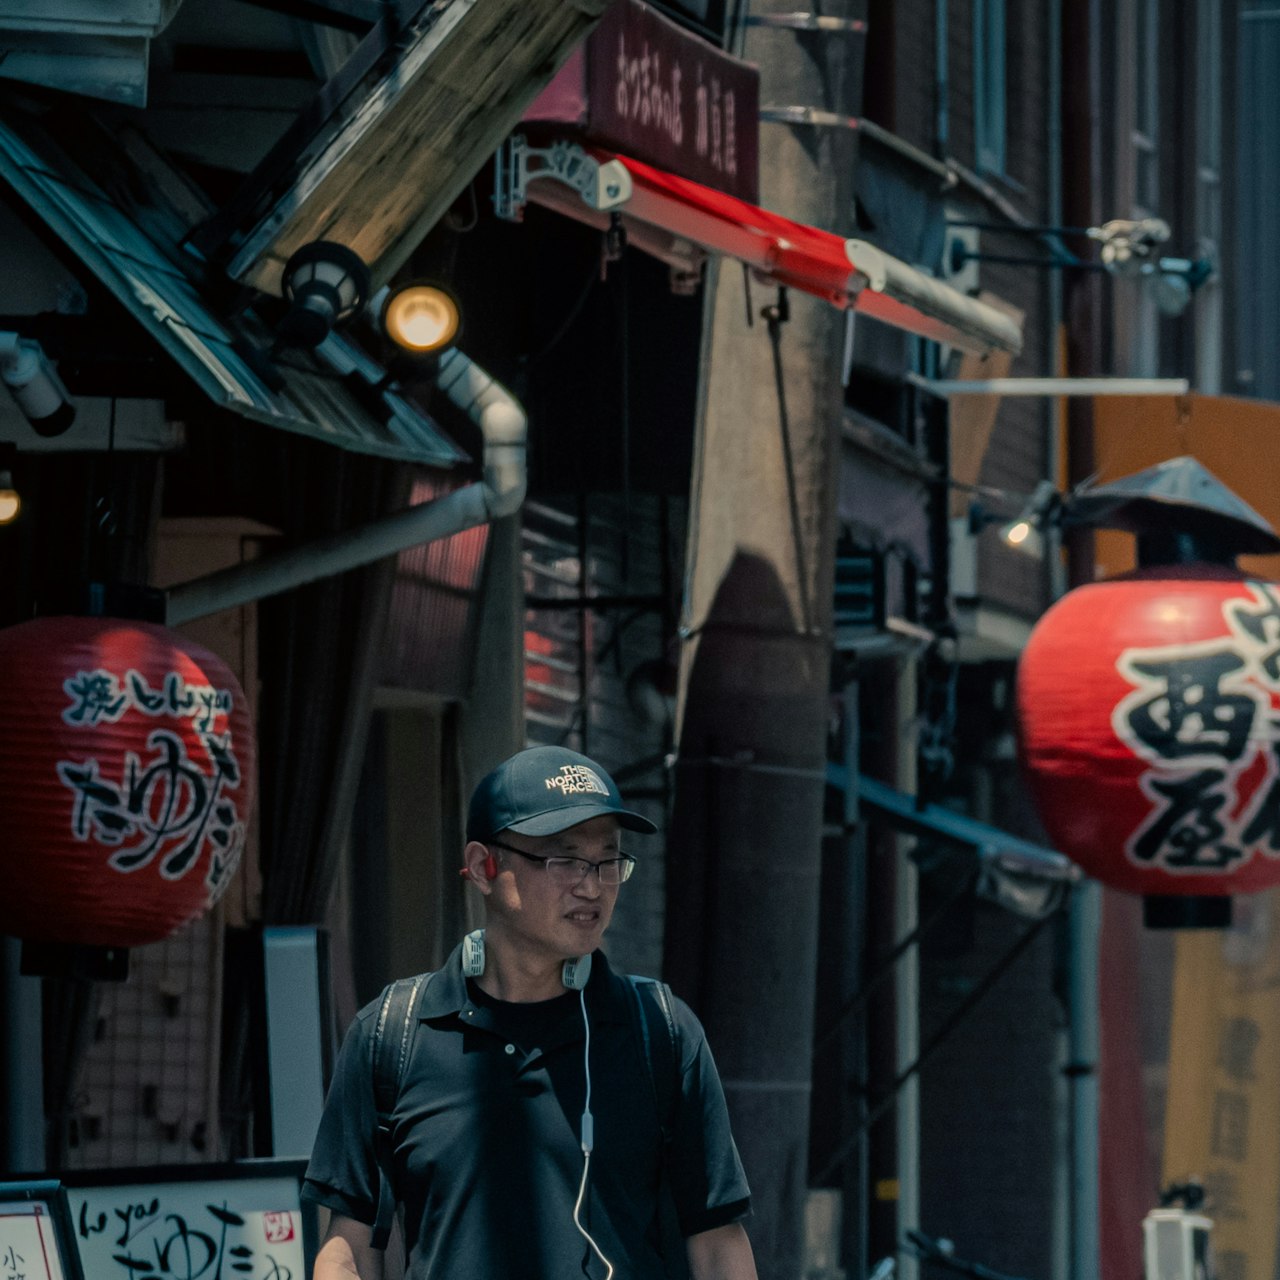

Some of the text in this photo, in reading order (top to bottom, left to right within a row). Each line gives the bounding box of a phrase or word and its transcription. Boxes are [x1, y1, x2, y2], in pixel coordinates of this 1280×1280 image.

[560, 765, 586, 775] THE
[545, 774, 590, 789] NORTH
[562, 782, 594, 795] FACE
